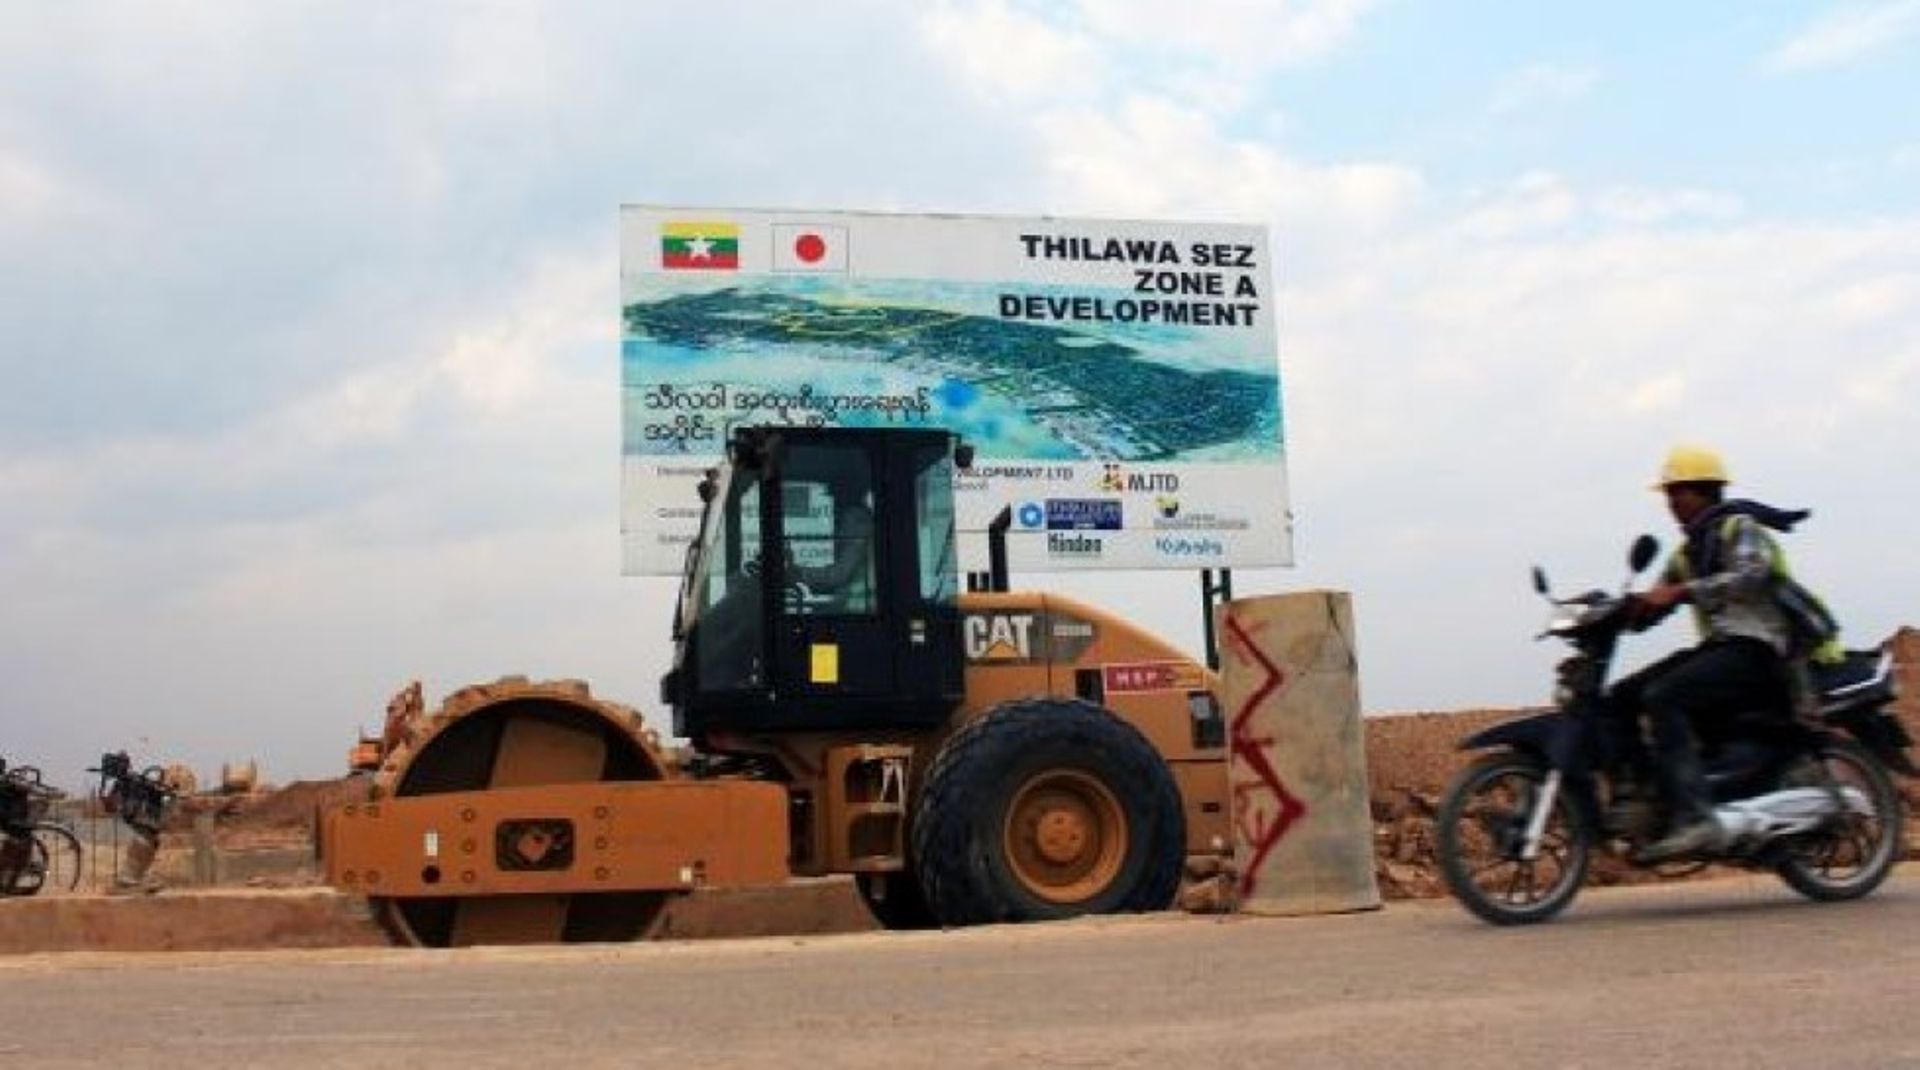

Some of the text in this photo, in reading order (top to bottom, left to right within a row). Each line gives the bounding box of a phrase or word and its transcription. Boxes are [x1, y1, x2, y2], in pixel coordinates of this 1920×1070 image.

[1020, 235, 1256, 267] THILAWA SEZ
[1134, 270, 1257, 297] ZONE A
[1000, 294, 1259, 326] DEVELOPMENT
[1128, 474, 1179, 491] MJTD
[966, 615, 1033, 658] CAT
